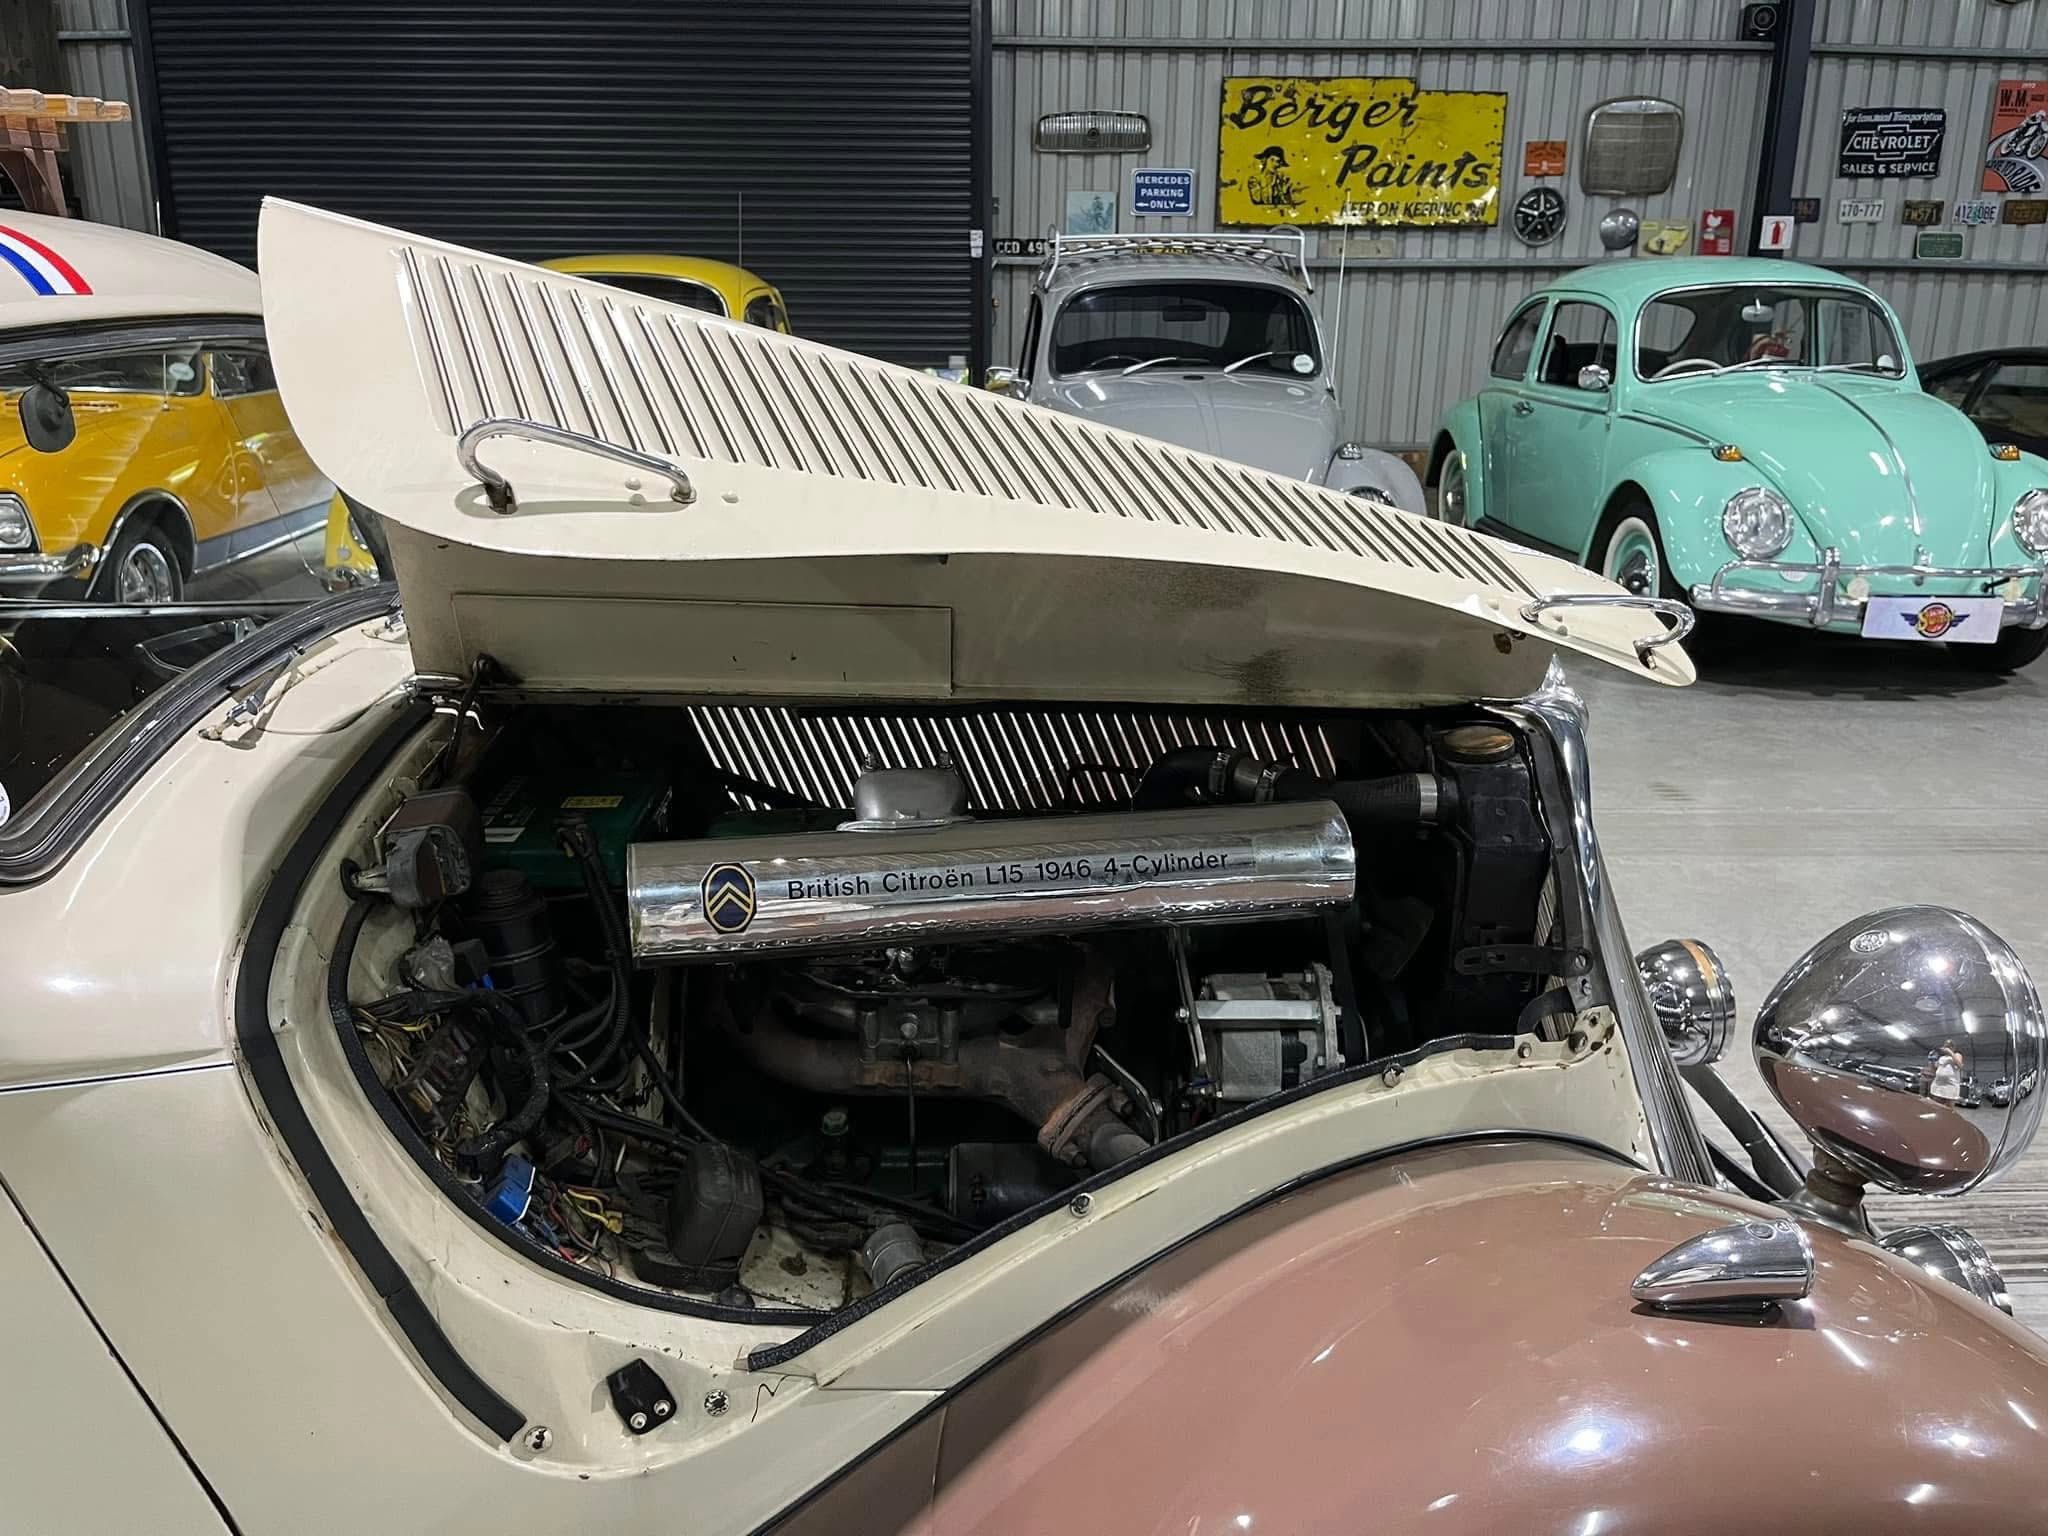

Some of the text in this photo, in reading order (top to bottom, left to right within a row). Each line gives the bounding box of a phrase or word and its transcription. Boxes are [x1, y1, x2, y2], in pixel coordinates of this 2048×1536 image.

[1229, 85, 1419, 143] Berger
[1853, 135, 1931, 150] CHEVROLET
[1335, 144, 1493, 188] Paints
[1842, 162, 1936, 175] SALES & SERVICE
[1136, 175, 1190, 185] MERCEDES
[1140, 188, 1184, 198] PARKING
[1149, 200, 1176, 209] ONLY
[1377, 201, 1399, 217] ON
[787, 851, 1229, 899] British Citroën L15 1946 4-Cylinder
